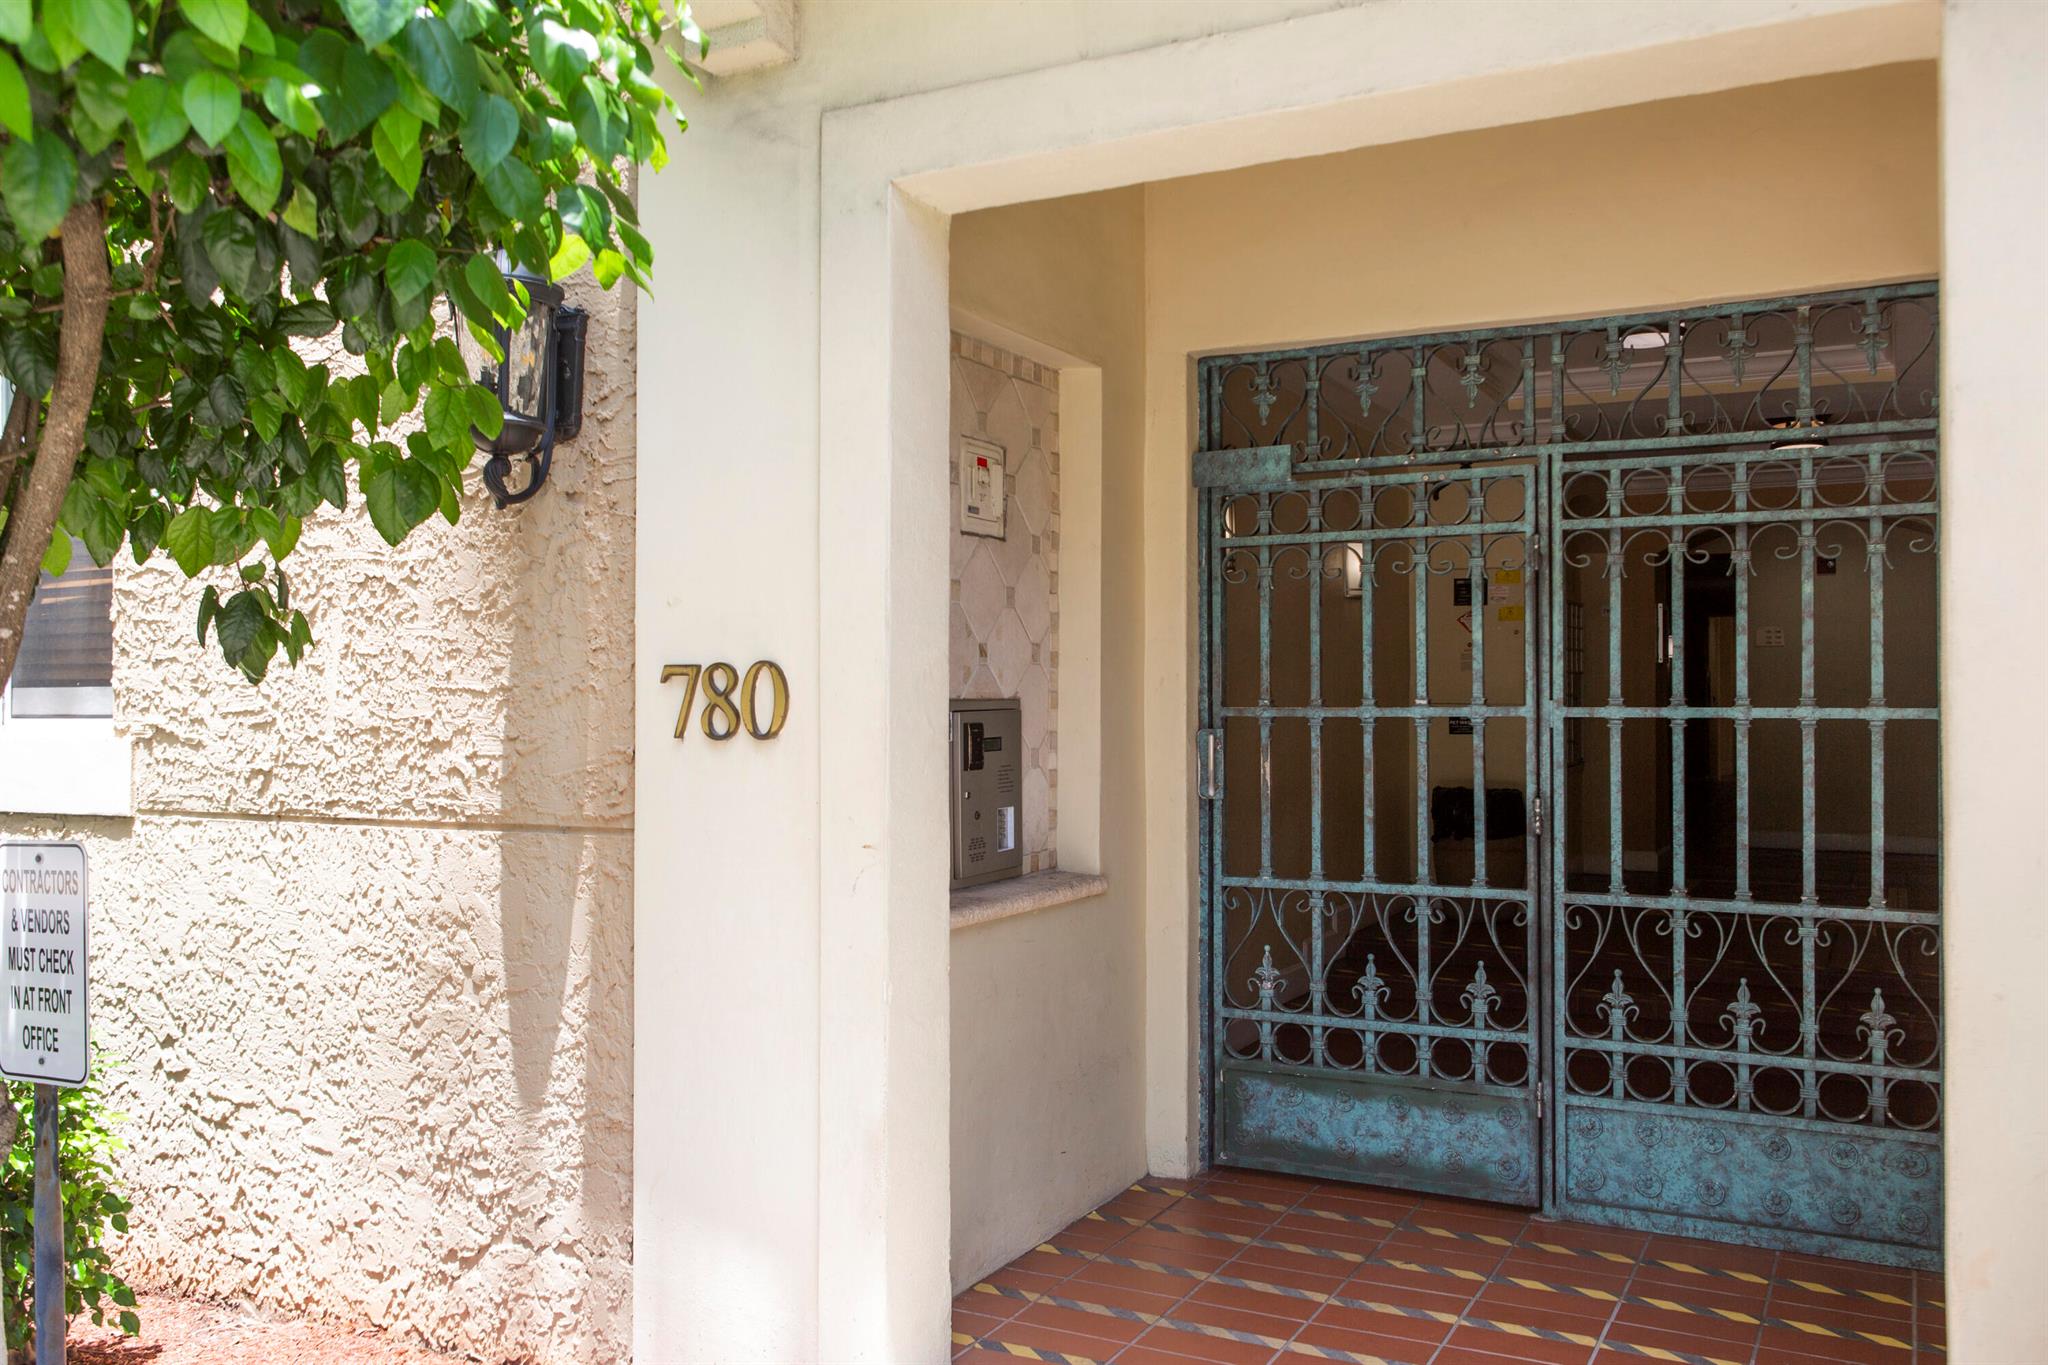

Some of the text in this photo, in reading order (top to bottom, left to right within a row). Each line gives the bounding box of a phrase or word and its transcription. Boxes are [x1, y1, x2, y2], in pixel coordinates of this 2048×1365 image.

[660, 660, 789, 741] 780
[2, 869, 79, 896] CONTRACTORS
[11, 908, 70, 935] & VENDORS
[8, 946, 74, 975] MUST CHECK
[10, 985, 72, 1014] IN AT FRONT
[22, 1024, 59, 1052] OFFICE
